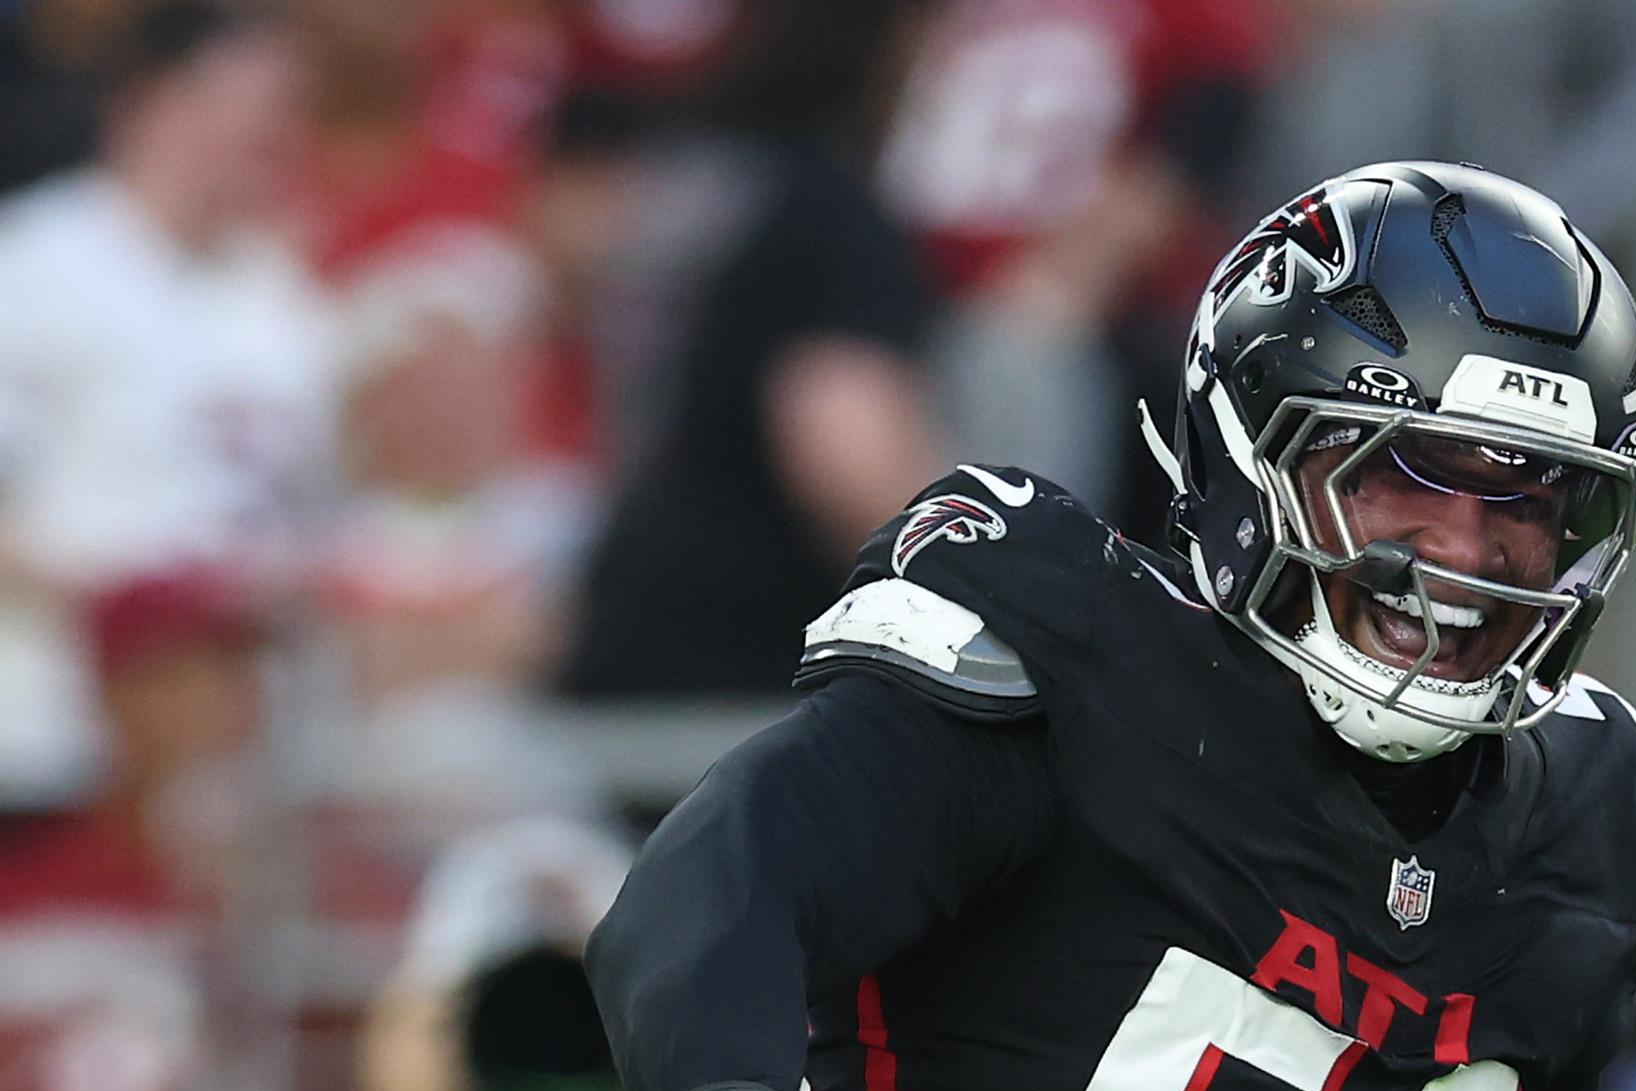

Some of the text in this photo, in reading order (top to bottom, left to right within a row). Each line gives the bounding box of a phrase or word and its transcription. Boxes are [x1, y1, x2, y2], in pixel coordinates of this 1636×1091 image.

[1346, 379, 1418, 408] OAKLEY
[1498, 369, 1568, 406] ATL
[1393, 887, 1422, 917] NFL
